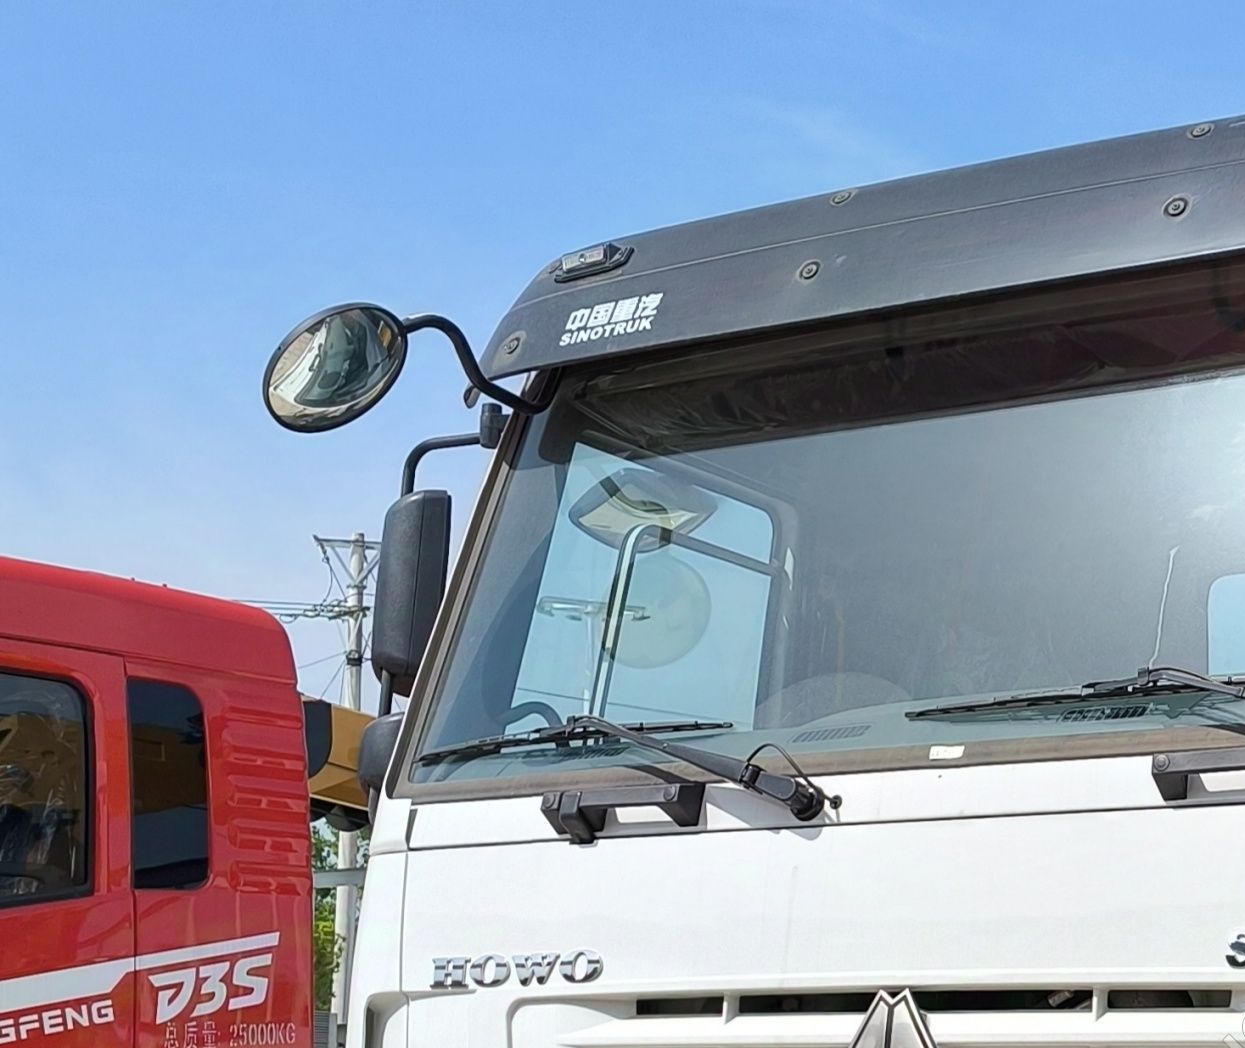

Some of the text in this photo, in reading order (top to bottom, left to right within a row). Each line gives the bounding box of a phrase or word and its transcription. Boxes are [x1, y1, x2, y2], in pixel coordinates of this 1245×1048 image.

[559, 316, 655, 347] SINOTRUK
[564, 292, 664, 331] 中国重汽
[148, 953, 273, 1024] D3S
[429, 949, 605, 990] HOWO
[0, 999, 115, 1044] GFENG
[228, 1021, 297, 1048] 25000KG
